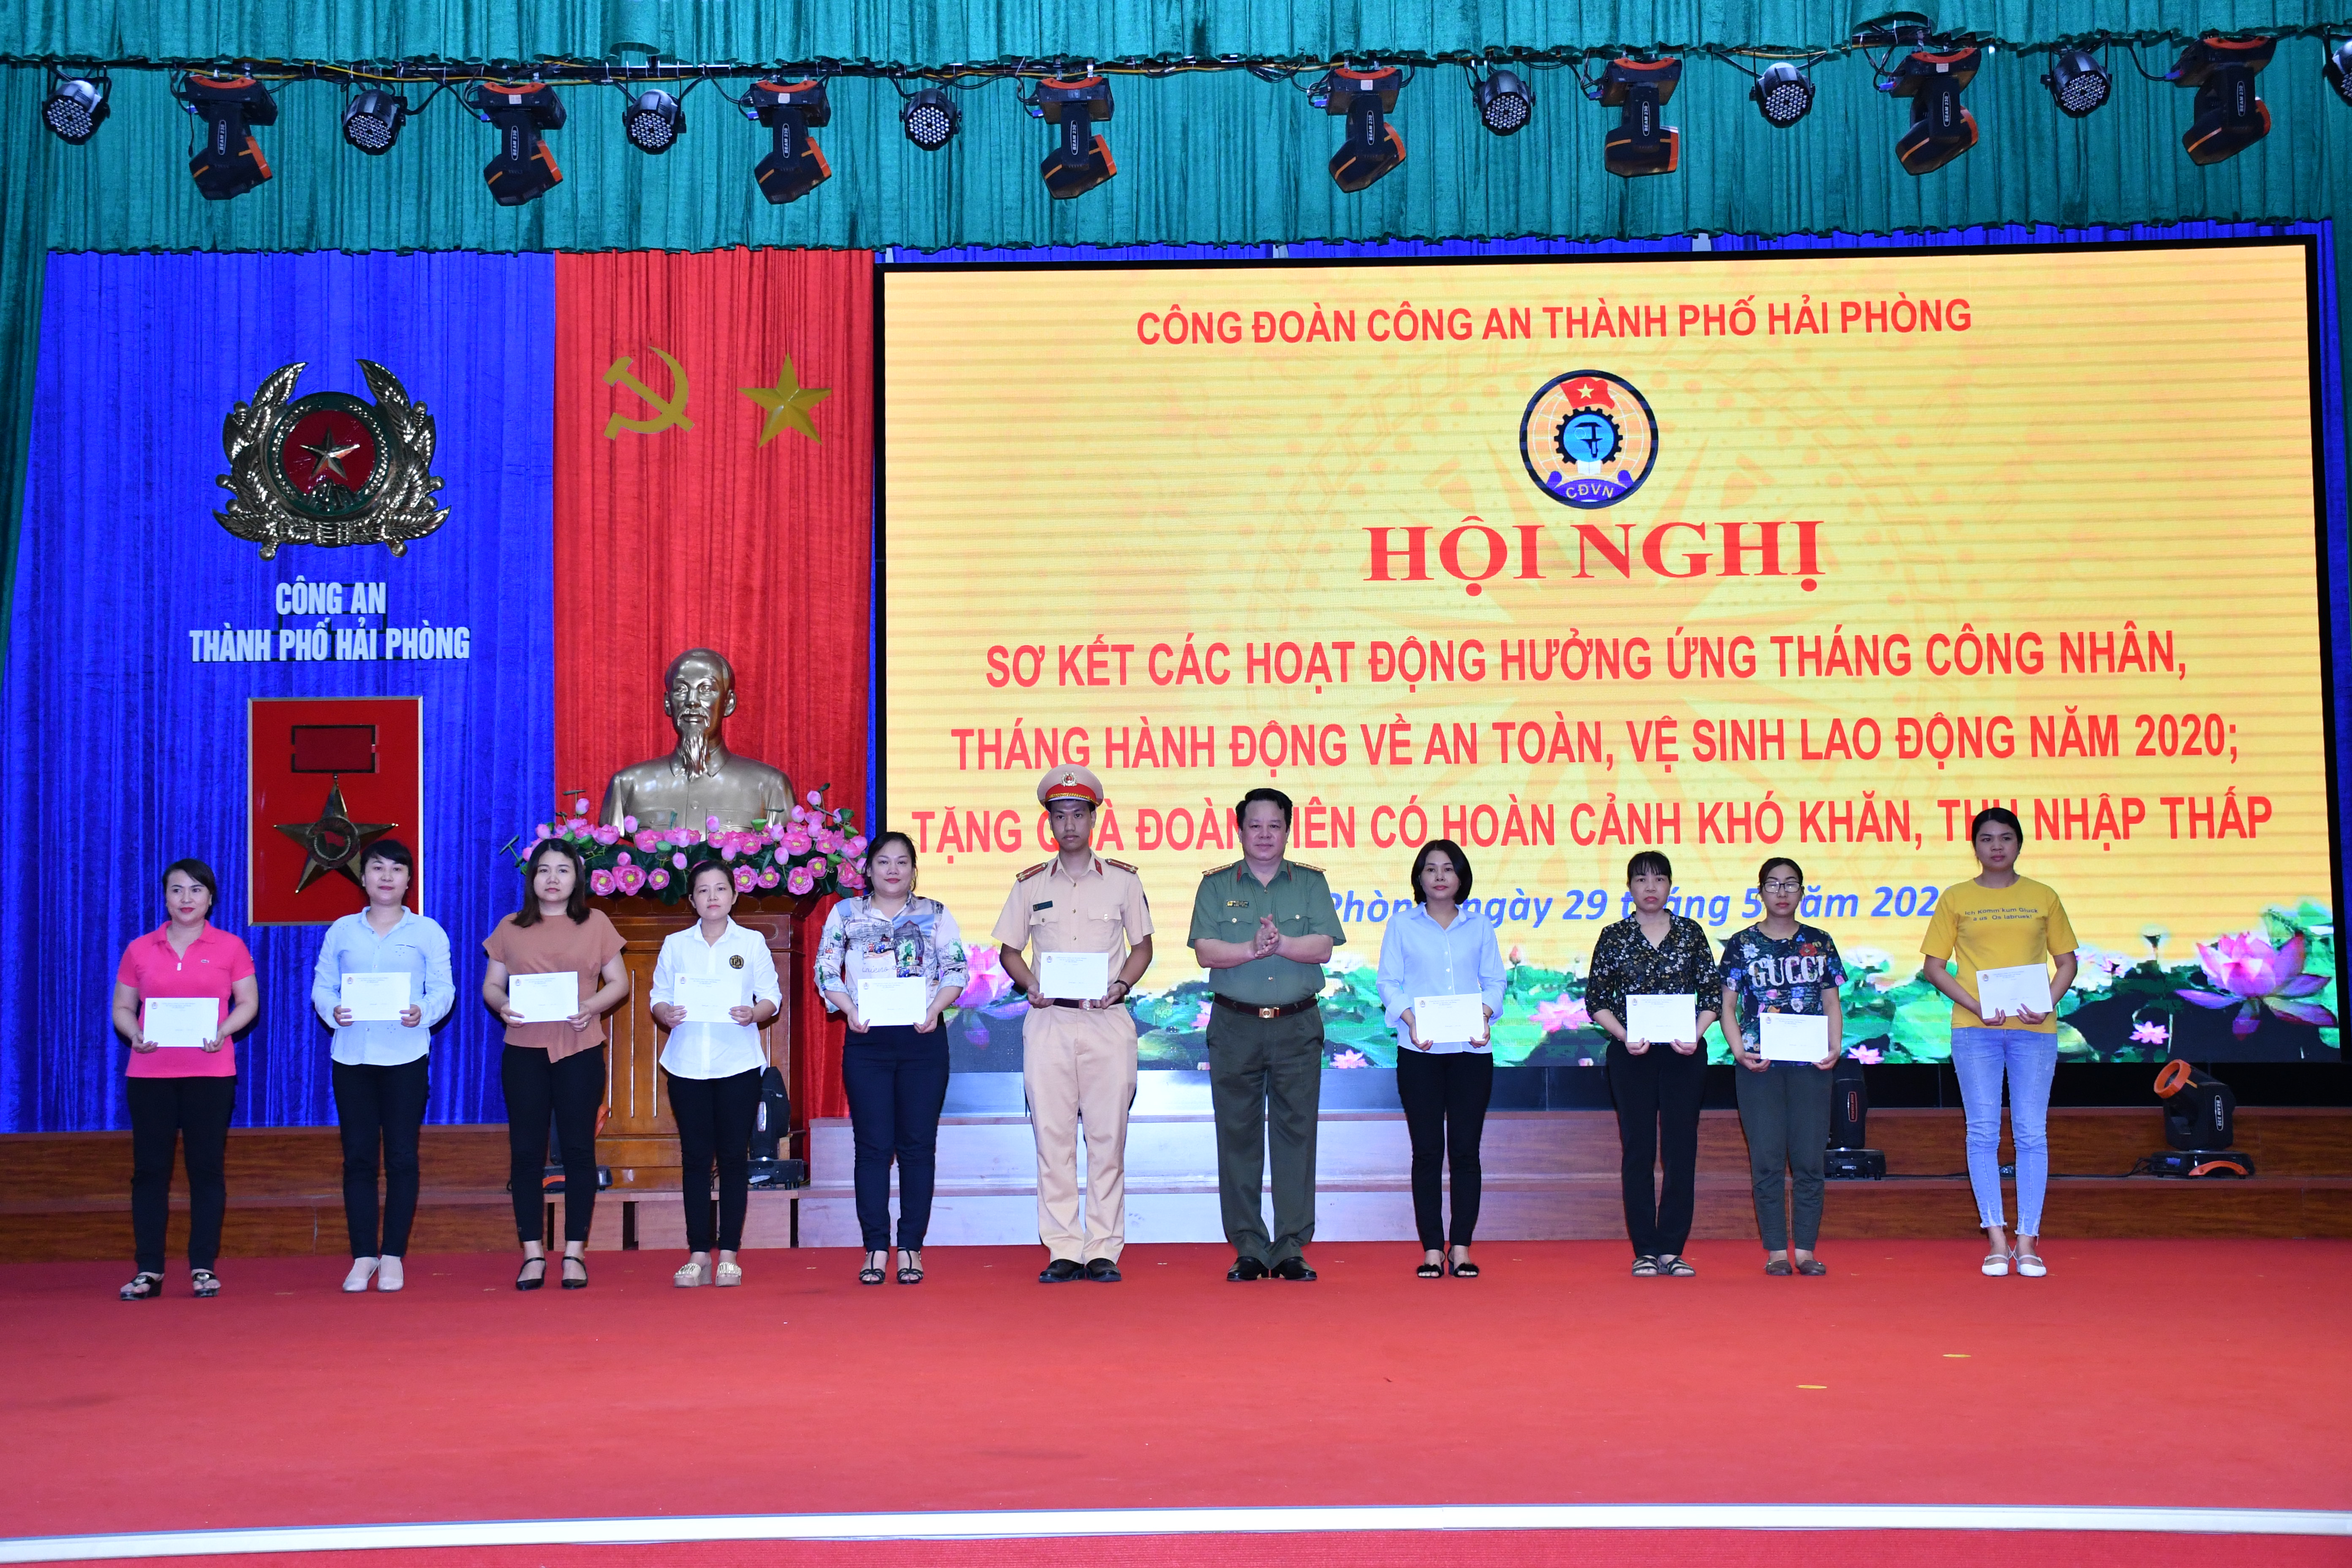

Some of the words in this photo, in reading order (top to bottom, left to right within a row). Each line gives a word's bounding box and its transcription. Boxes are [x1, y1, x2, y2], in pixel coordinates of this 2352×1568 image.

[1138, 304, 1242, 345] CÔNG
[1252, 302, 1355, 343] ĐOÀN
[1368, 301, 1472, 341] CÔNG
[1483, 308, 1530, 339] AN
[1543, 298, 1666, 338] THÀNH
[1679, 295, 1756, 336] PHỐ
[1769, 294, 1828, 335] HẢI
[1841, 292, 1971, 333] PHÒNG
[1565, 484, 1614, 499] CĐVN
[1363, 516, 1546, 596] HỘI
[1571, 521, 1825, 591] NGHỊ
[276, 575, 343, 615] CÔNG
[350, 582, 386, 614] AN
[189, 623, 271, 662] THÀNH
[280, 618, 330, 661] PHỐ
[336, 617, 377, 660] HẢI
[386, 620, 470, 659] PHÒNG
[987, 645, 1045, 687] SƠ
[1059, 634, 1134, 686] KẾT
[1149, 633, 1230, 686] CÁC
[1247, 642, 1355, 694] HOẠT
[1369, 636, 1485, 692] ĐỘNG
[1501, 628, 1651, 681] HƯỞNG
[1667, 626, 1756, 679] ỨNG
[1770, 624, 1911, 677] THÁNG
[1926, 623, 2044, 675] CÔNG
[2060, 621, 2186, 680] NHÂN,
[951, 718, 1089, 770] THÁNG
[1105, 716, 1214, 768] HÀNH
[1229, 720, 1346, 777] ĐỘNG
[1361, 713, 1412, 765] VỀ
[1424, 723, 1477, 764] AN
[1492, 711, 1613, 771] TOÀN,
[1626, 716, 1678, 773] VỆ
[1693, 719, 1784, 762] SINH
[1801, 717, 1881, 760] LAO
[1895, 712, 2014, 769] ĐỘNG
[2030, 705, 2118, 757] NĂM
[2135, 713, 2238, 764] 2020;
[912, 806, 1021, 863] TẶNG
[1037, 798, 1124, 852] QÀ
[1293, 797, 1355, 848] IÊN
[1371, 795, 1427, 848] CÓ
[1443, 794, 1554, 847] HOÀN
[1571, 793, 1680, 846] CẢNH
[1699, 791, 1783, 844] KHÓ
[1800, 790, 1922, 850] KHĂN,
[1938, 799, 2017, 841] TH
[2034, 793, 2145, 851] NHẬP
[2160, 786, 2272, 839] THẤP
[1330, 890, 1412, 922] hòn
[1463, 888, 1553, 928] ngày
[1563, 890, 1607, 920] 29
[1621, 887, 1730, 926] táng
[1742, 888, 1762, 918] 5
[1800, 885, 1858, 917] ăm
[1871, 886, 1939, 917] 202
[1748, 956, 1825, 987] GUCCI
